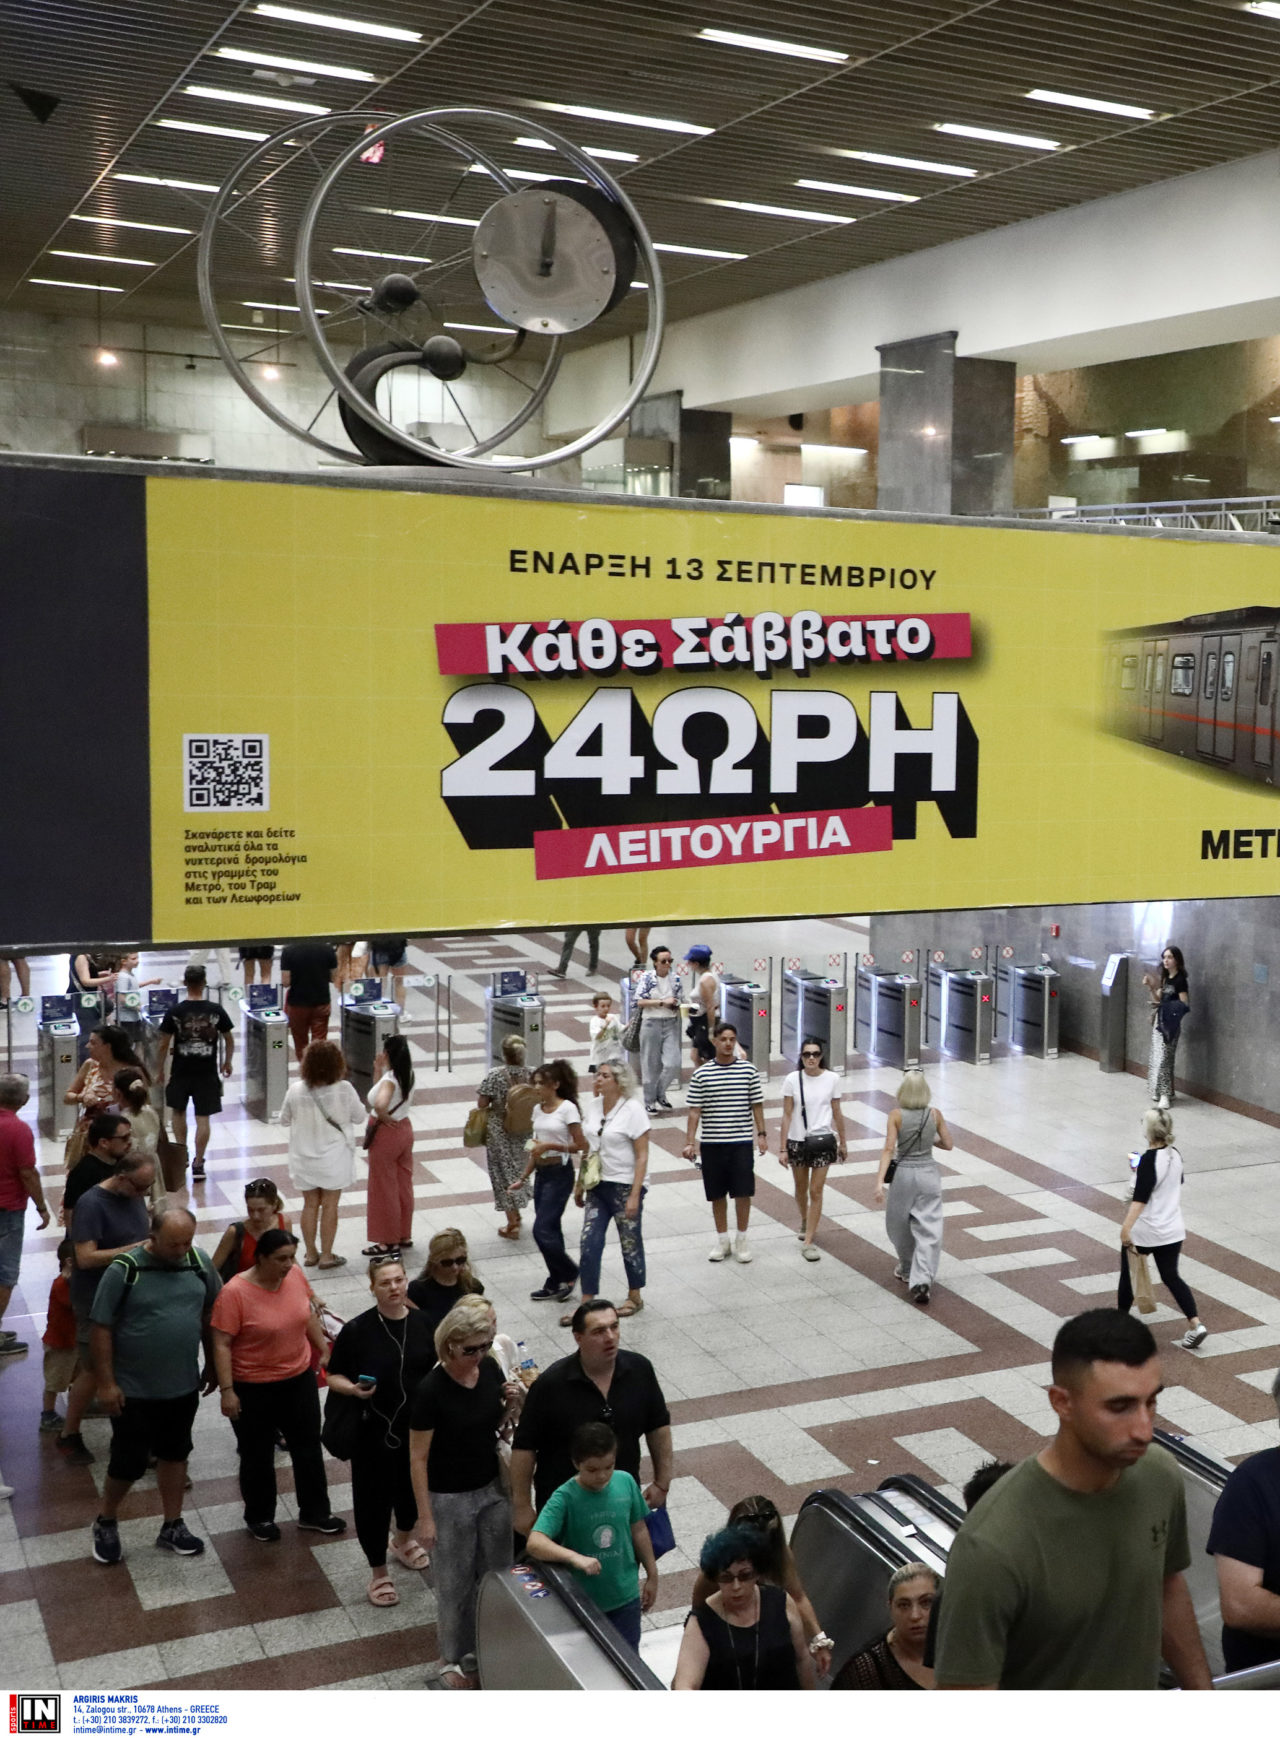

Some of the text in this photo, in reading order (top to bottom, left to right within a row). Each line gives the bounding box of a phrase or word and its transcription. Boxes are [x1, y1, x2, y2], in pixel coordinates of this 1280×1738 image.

[509, 549, 936, 590] ΕΝΑΡΞΗ 13 ΣΕΠΤΕΜΒΡΙΟΥ
[485, 610, 931, 674] Κάθε Σάββατο
[441, 683, 958, 798] 24ΩΡΗ
[184, 827, 296, 841] Σκανάρετε και δείτε
[584, 814, 851, 869] ΛΕΙΤΟΥΡΓΙΑ
[184, 841, 278, 853] αναλυτικά όλα τα
[184, 852, 307, 867] νυκτερινά δρομολόγια
[184, 866, 279, 880] στις γραμμές του
[185, 879, 276, 893] Μετρό, του Τραμ
[185, 890, 301, 905] και των Λεωφορείων
